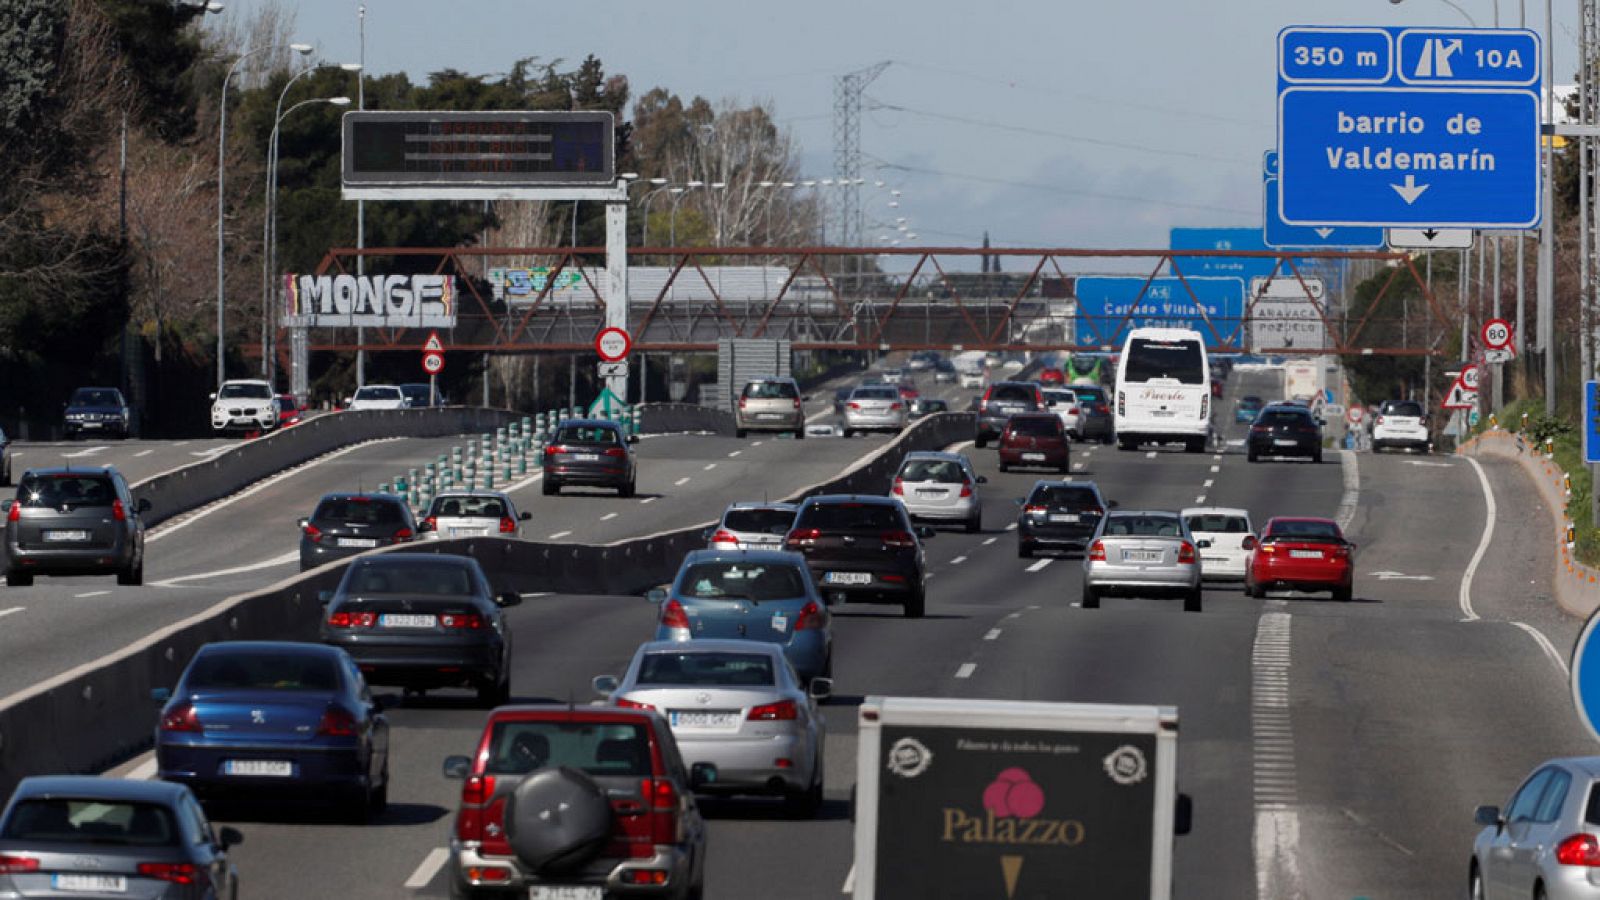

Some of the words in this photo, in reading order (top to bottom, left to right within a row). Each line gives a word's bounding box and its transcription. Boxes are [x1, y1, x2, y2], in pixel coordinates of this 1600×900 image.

[1294, 46, 1344, 66] 350
[1356, 51, 1378, 66] m
[1475, 49, 1523, 69] 10A
[1337, 112, 1425, 135] barrio
[1446, 113, 1482, 135] de
[1326, 146, 1496, 171] Valdemarín
[300, 274, 446, 316] MONGE
[1488, 328, 1506, 340] 80
[942, 807, 1086, 846] Palazzo
